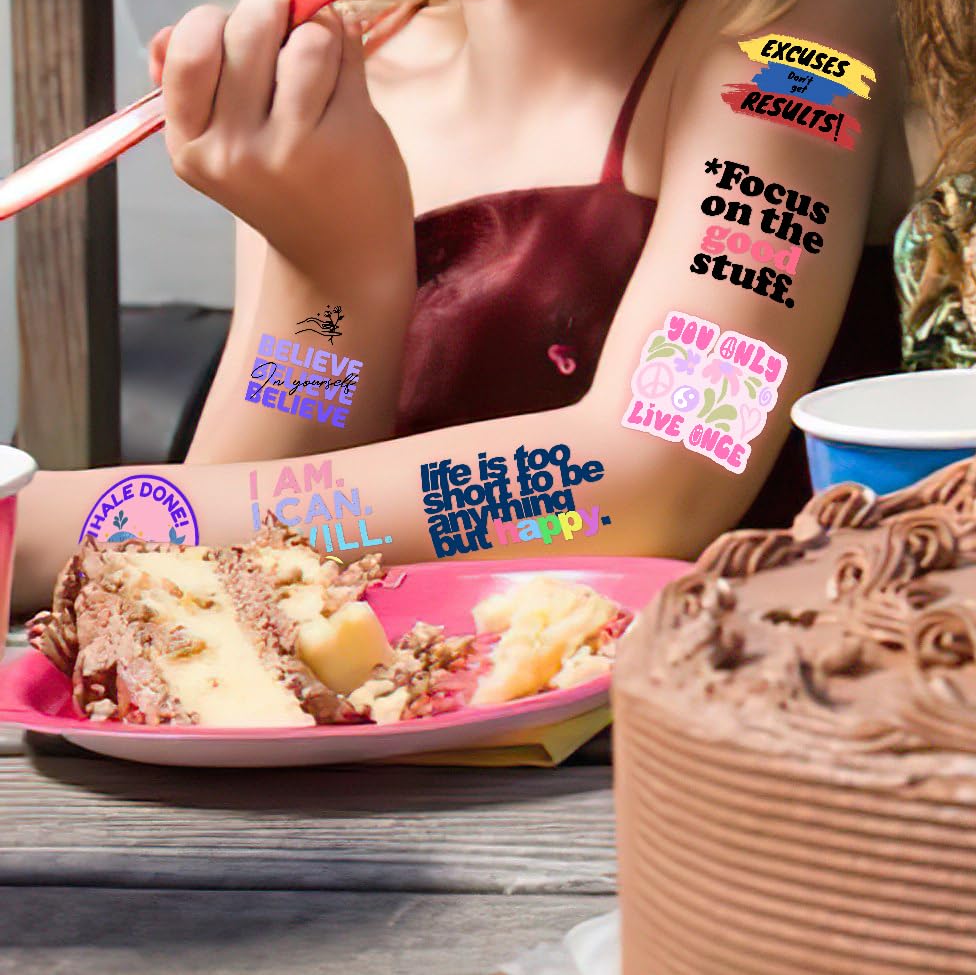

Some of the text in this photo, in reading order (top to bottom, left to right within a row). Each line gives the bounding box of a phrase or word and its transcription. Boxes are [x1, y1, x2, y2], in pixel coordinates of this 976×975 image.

[760, 39, 850, 78] EXCUSES
[787, 71, 813, 85] Don't
[790, 85, 808, 93] get
[740, 91, 844, 142] RESULTS!
[700, 195, 824, 254] on the
[700, 225, 802, 275] good
[689, 253, 795, 308] stuff.
[257, 334, 364, 383] BELIEVE
[245, 381, 350, 428] BELIEVE
[288, 372, 358, 395] yourself
[421, 444, 571, 492] life is too
[688, 424, 746, 467] ONCE
[250, 460, 345, 500] I AM.
[423, 460, 604, 514] short to be
[87, 482, 189, 538] HALE DONE!
[252, 488, 372, 532] I CAN.
[428, 489, 576, 535] anything
[429, 505, 611, 558] but happy.
[309, 519, 393, 553] ILL.
